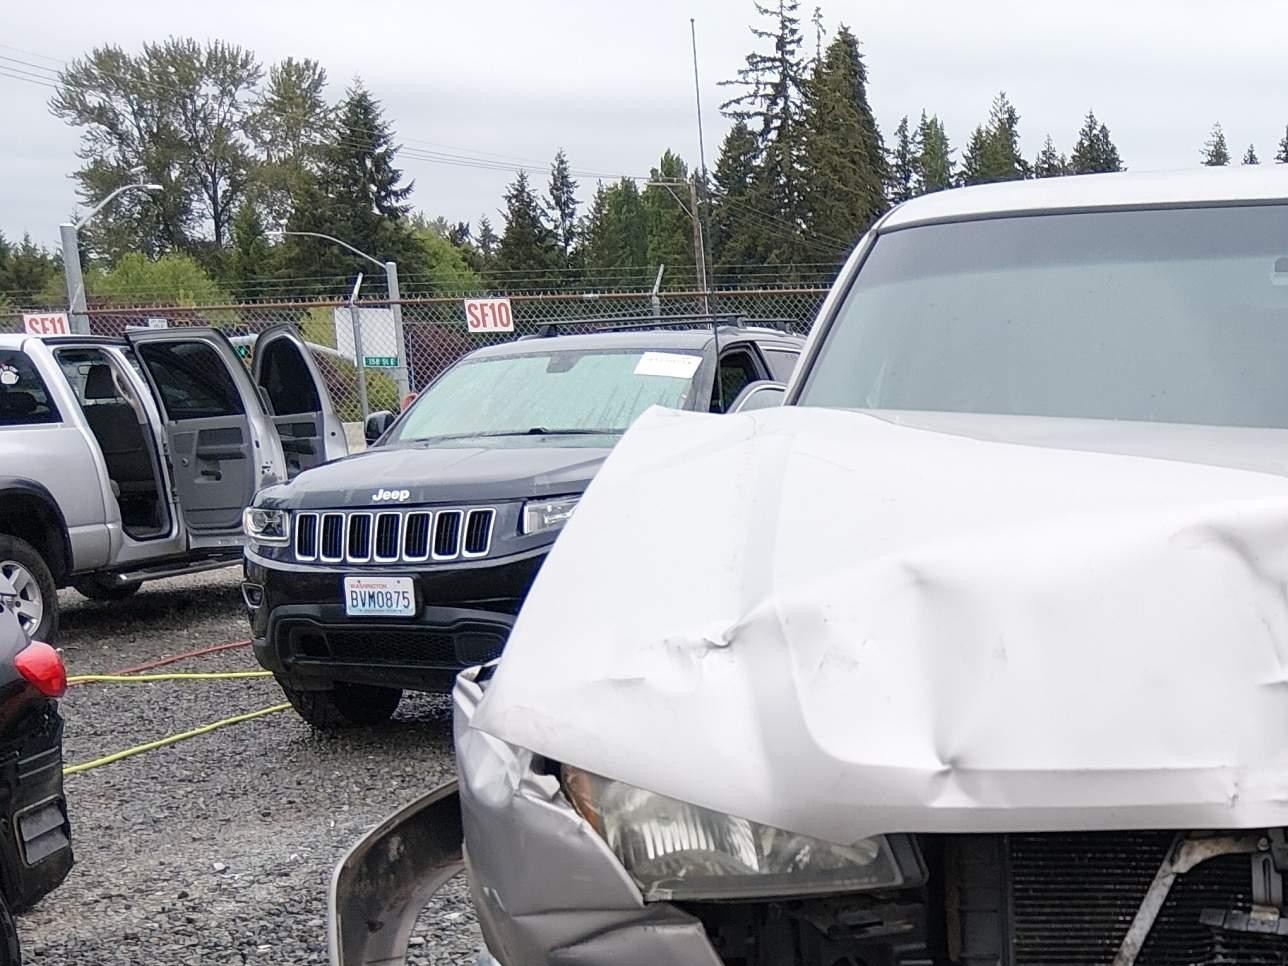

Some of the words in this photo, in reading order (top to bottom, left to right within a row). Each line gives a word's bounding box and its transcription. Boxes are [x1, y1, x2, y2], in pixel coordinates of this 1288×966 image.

[467, 302, 511, 329] SF10
[28, 316, 66, 335] SF11
[372, 488, 410, 502] Jeep
[350, 590, 411, 609] BVM0875
